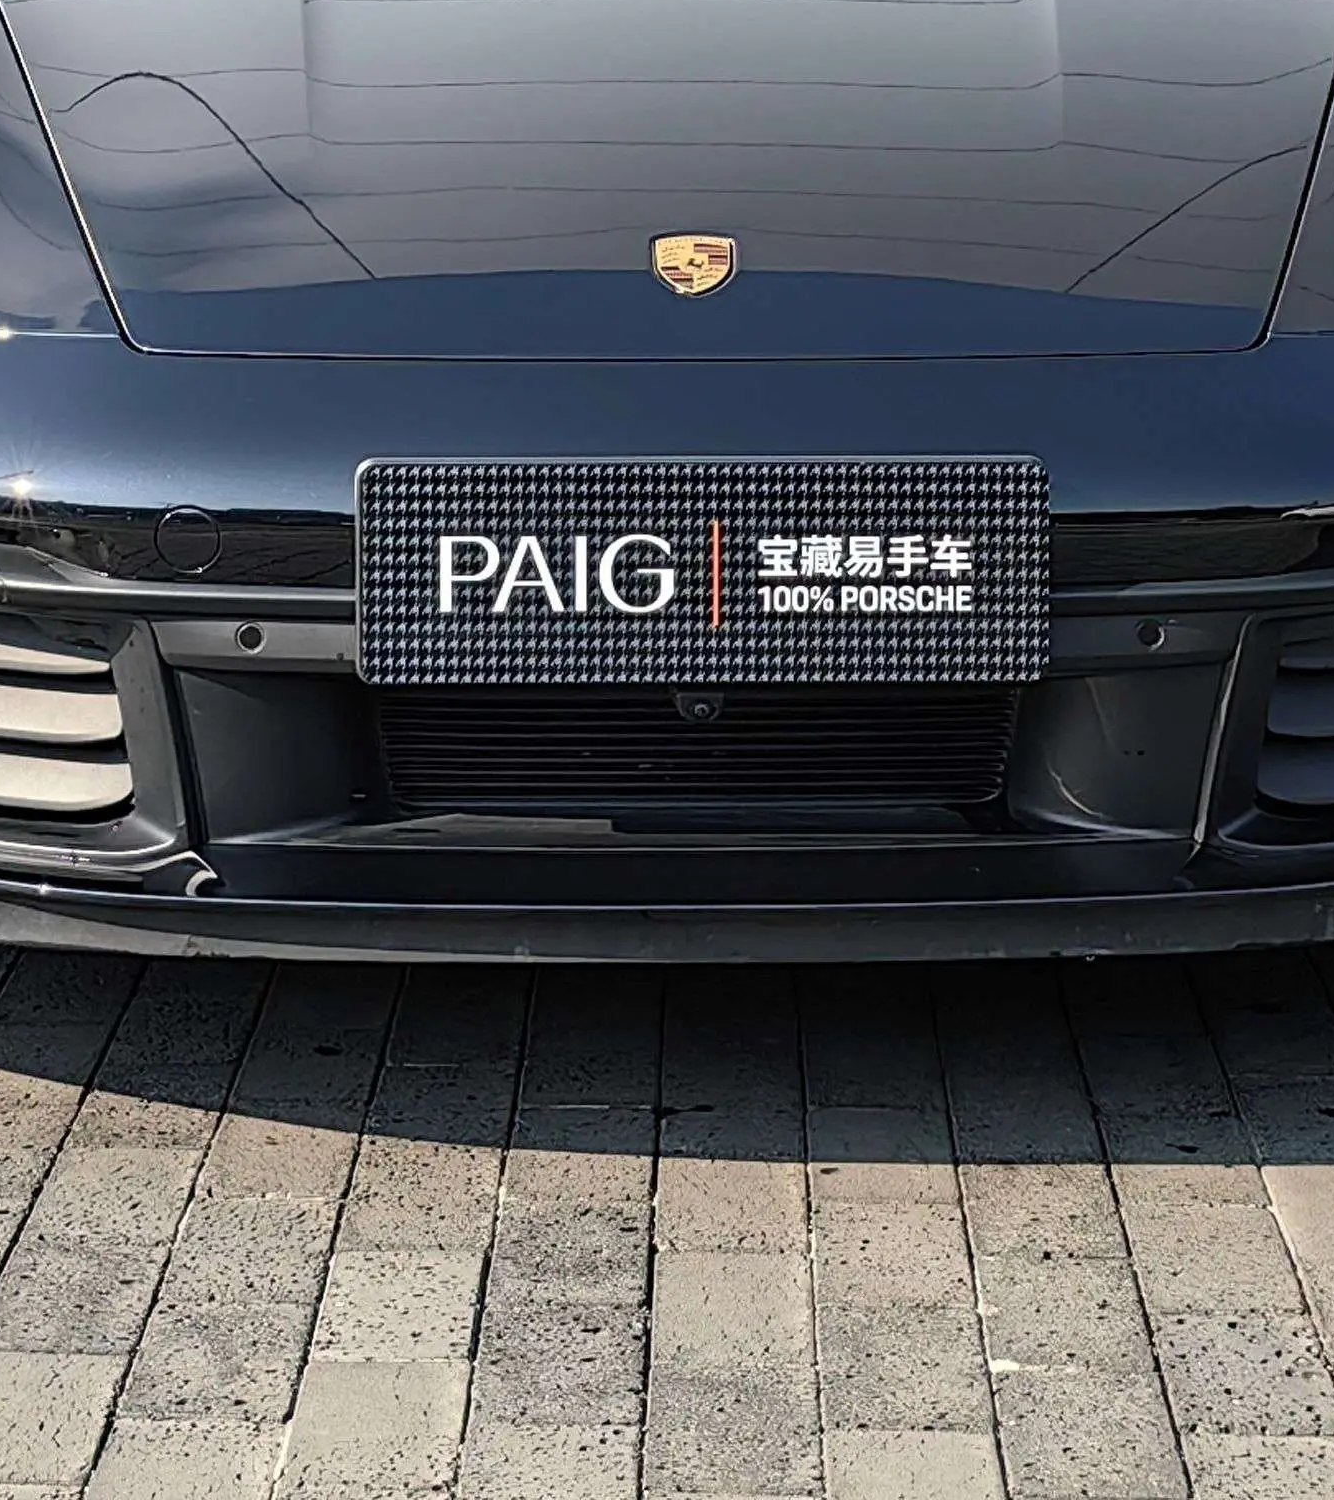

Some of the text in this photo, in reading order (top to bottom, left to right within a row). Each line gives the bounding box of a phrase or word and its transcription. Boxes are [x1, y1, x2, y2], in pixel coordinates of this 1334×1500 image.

[438, 533, 675, 614] PAIG
[757, 534, 972, 579] 宝藏易手车
[757, 585, 973, 613] 100% PORSCHE
